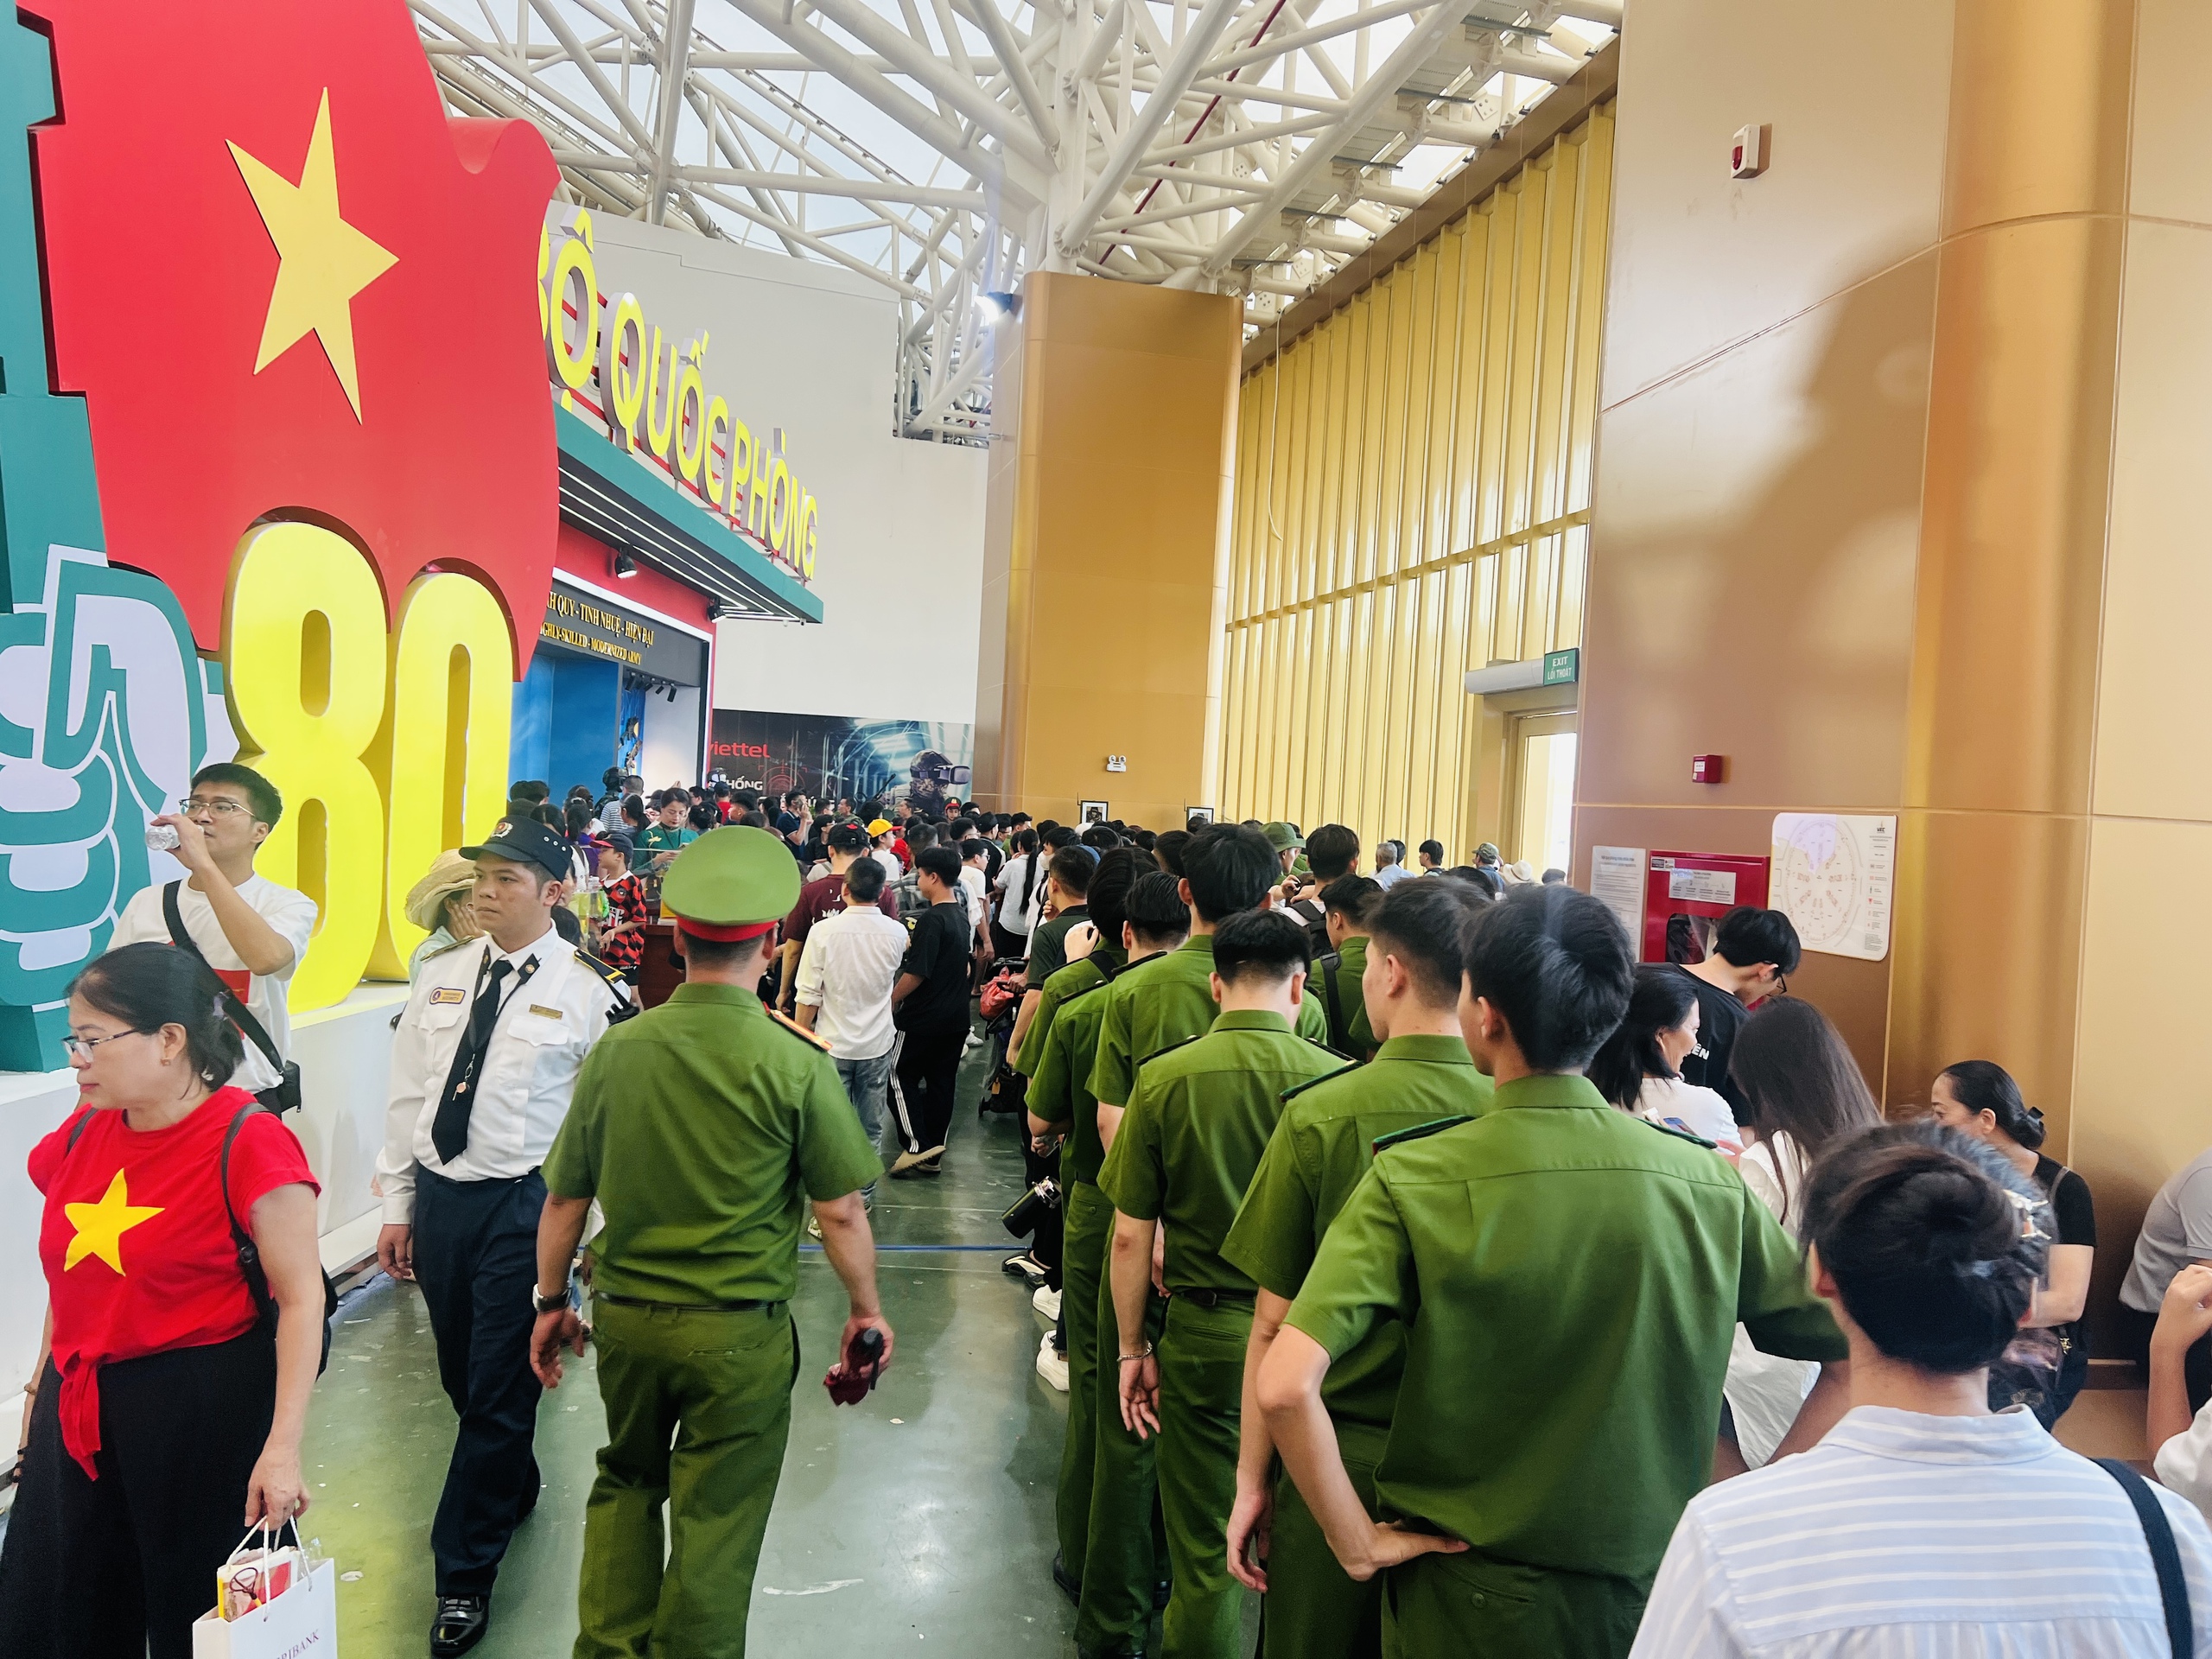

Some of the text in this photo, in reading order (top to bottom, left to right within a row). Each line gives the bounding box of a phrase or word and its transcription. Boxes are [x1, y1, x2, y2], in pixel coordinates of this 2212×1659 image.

[601, 292, 728, 505] QUỐC
[726, 418, 818, 582] PHÒNG
[557, 594, 575, 617] QUY
[580, 603, 600, 626] TINH
[601, 611, 621, 638] NHUỆ
[625, 620, 642, 643] HIỆN
[642, 627, 654, 648] ĐẠI
[590, 637, 627, 660] MODERNIZED
[627, 651, 642, 665] ARMY
[1552, 656, 1568, 667] EXIT
[1548, 665, 1572, 680] LỐI THOÁT
[225, 520, 513, 1015] 80
